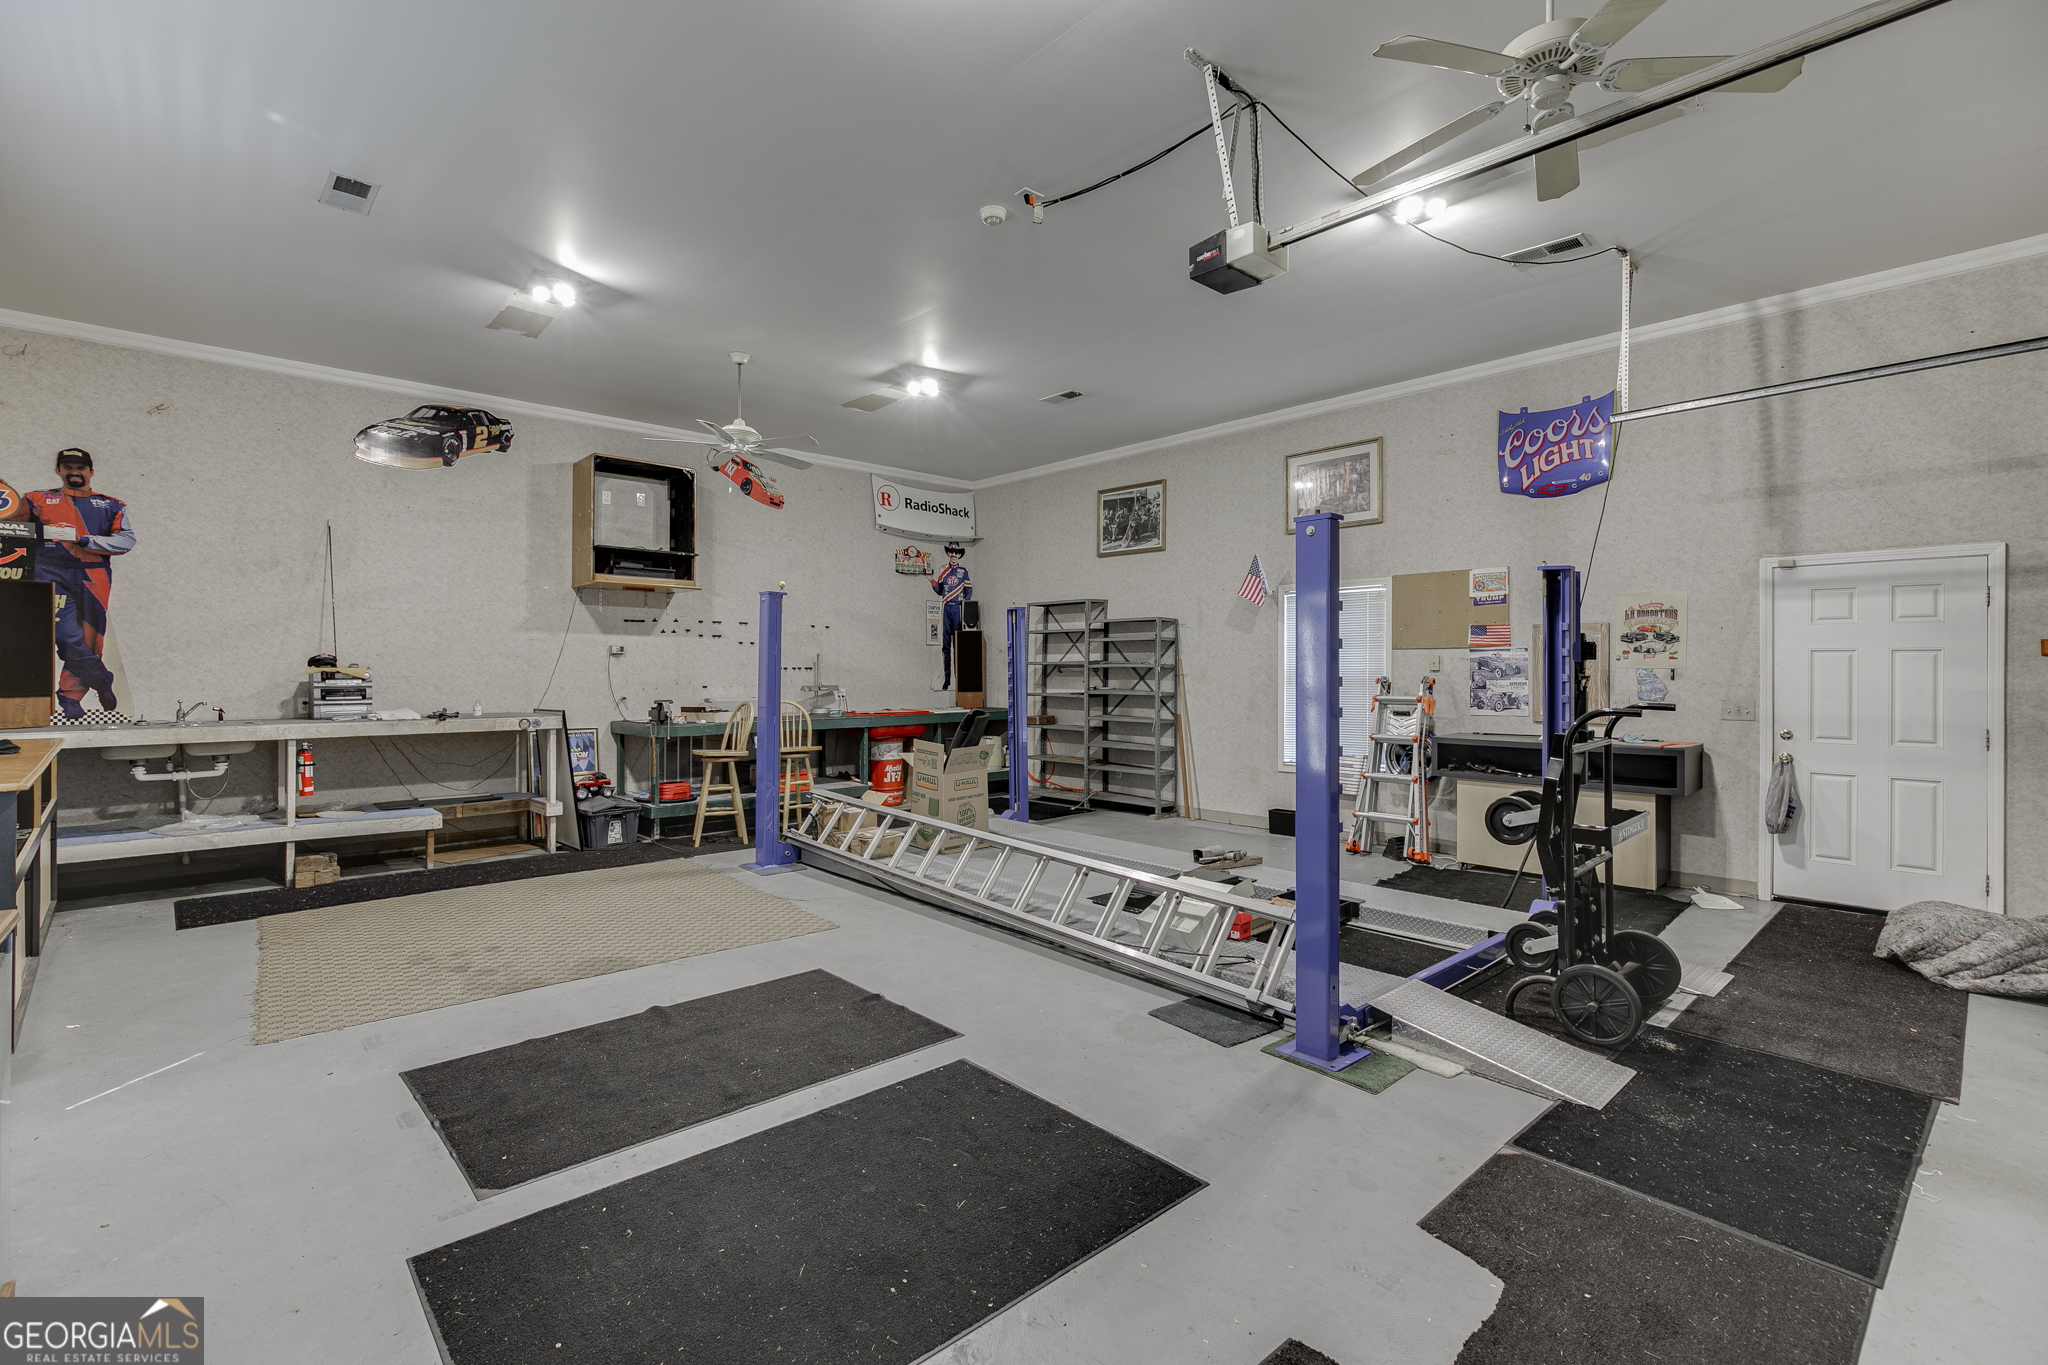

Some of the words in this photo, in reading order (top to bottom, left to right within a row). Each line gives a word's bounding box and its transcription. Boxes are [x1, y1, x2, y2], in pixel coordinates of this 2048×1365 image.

[473, 425, 489, 449] 2
[1499, 405, 1609, 470] Coors
[1519, 438, 1594, 492] LIGHT
[1579, 472, 1592, 482] 40
[0, 489, 13, 511] 6
[880, 491, 893, 507] R
[904, 497, 970, 519] RadioShack
[0, 566, 23, 580] OU
[1637, 608, 1678, 620] ROADSTERS
[959, 806, 973, 818] 100%
